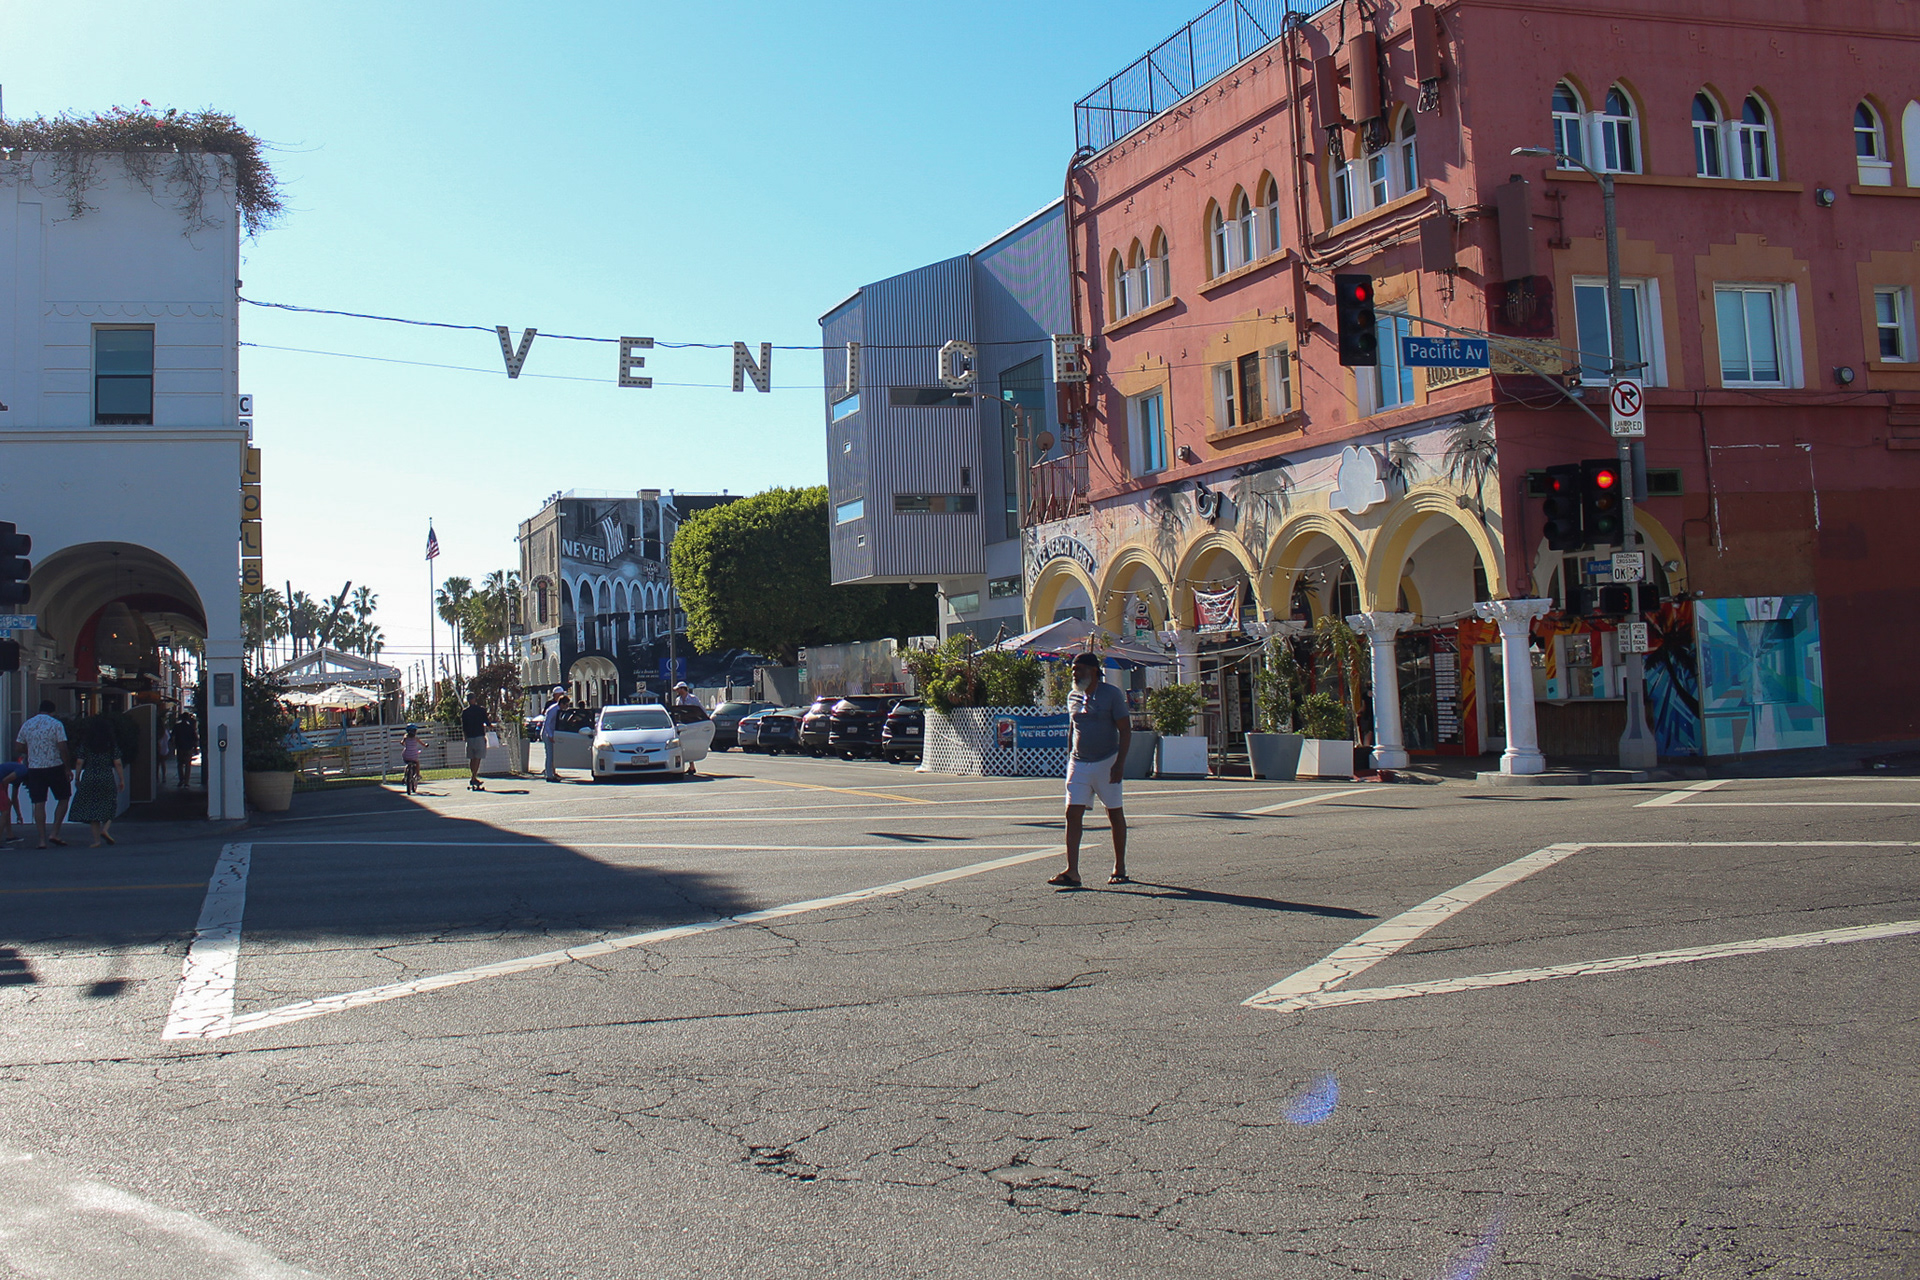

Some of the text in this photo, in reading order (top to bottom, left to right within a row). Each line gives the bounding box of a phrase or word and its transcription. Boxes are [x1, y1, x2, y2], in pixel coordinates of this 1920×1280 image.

[495, 325, 1087, 393] VENICE
[1409, 343, 1483, 360] Pacific Av
[561, 538, 606, 563] NEVER
[1046, 538, 1070, 558] BEACH
[1071, 541, 1093, 573] MART
[1614, 568, 1626, 580] OK
[1019, 729, 1046, 738] WE'RE
